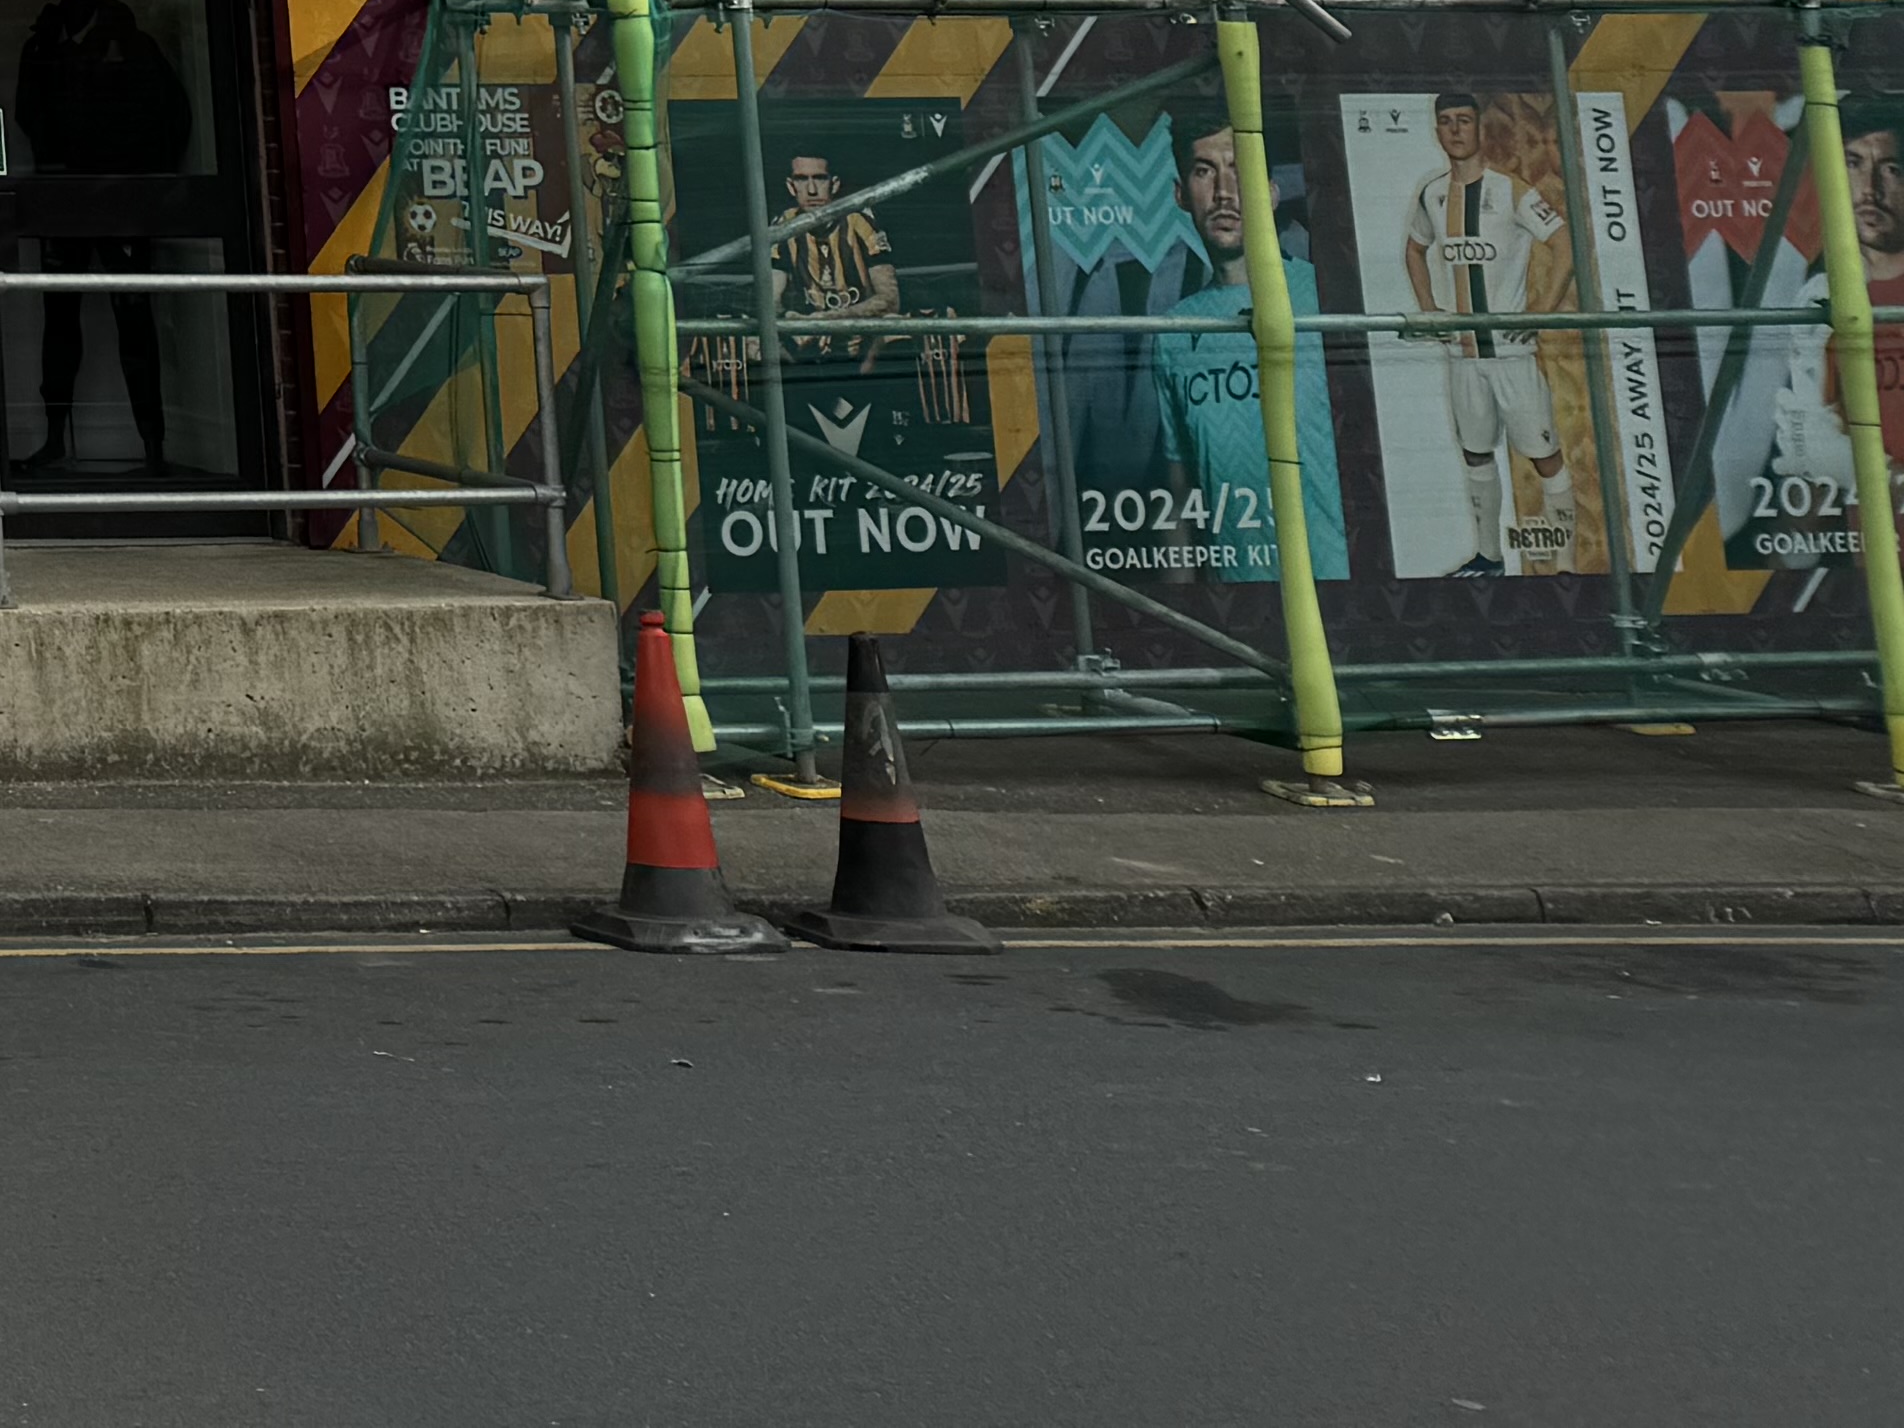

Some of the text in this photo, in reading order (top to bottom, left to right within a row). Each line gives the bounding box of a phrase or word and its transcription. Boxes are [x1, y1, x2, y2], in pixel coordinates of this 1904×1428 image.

[407, 139, 448, 155] OIN
[1591, 107, 1619, 174] NOW
[462, 200, 561, 241] TIS WAY!
[1048, 206, 1134, 225] UT NOW
[1602, 185, 1626, 242] OUT
[1691, 198, 1773, 219] OUT NO
[1619, 339, 1651, 421] AWAY
[809, 475, 856, 508] KIT
[864, 469, 984, 500] 224/25
[721, 505, 985, 557] OUT NOW
[1508, 527, 1565, 549] RETRO
[1085, 545, 1238, 572] GOALKEEPER
